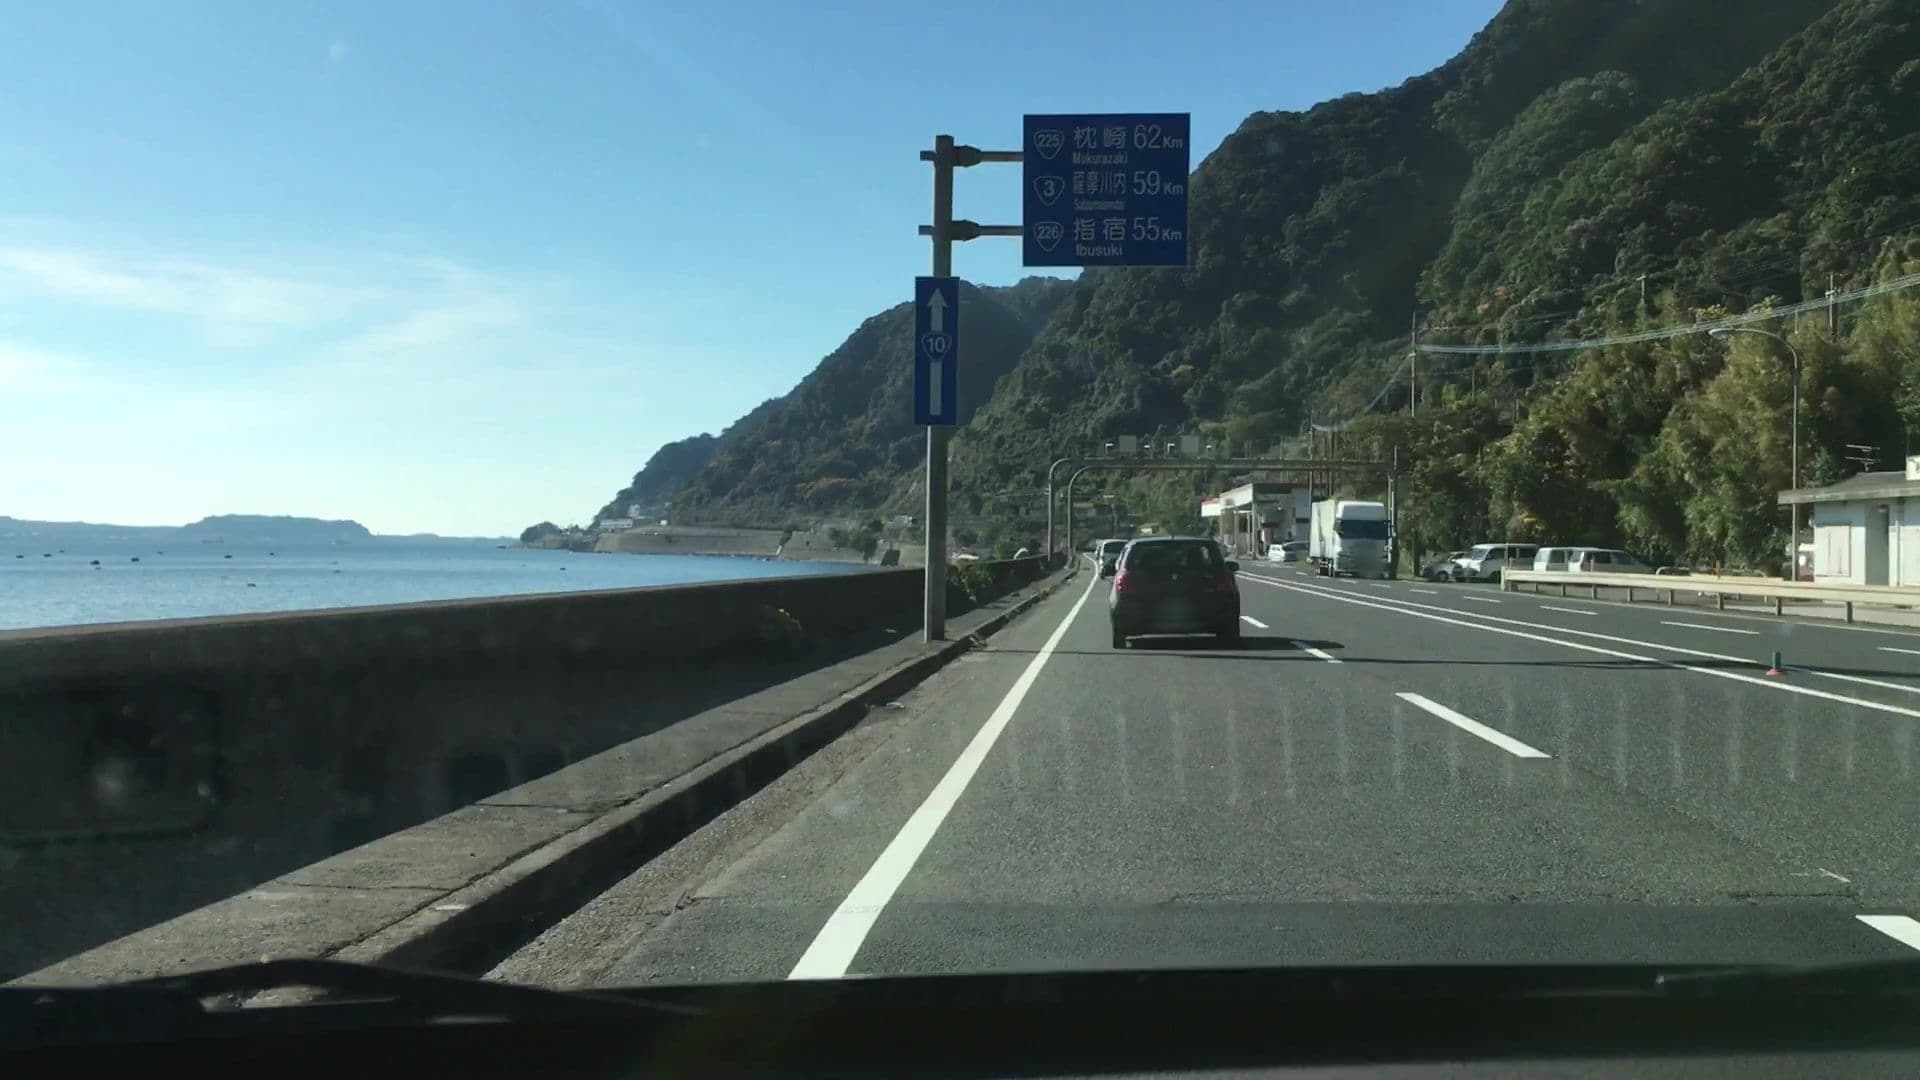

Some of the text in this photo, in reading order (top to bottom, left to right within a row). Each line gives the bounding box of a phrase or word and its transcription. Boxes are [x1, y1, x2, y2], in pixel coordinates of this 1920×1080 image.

[1038, 134, 1060, 147] 225
[1072, 125, 1127, 149] 枕崎
[1043, 179, 1055, 197] 3
[1038, 226, 1059, 240] 226
[1073, 216, 1127, 241] 指宿
[1075, 243, 1123, 257] Ibusuki
[927, 336, 945, 353] 10
